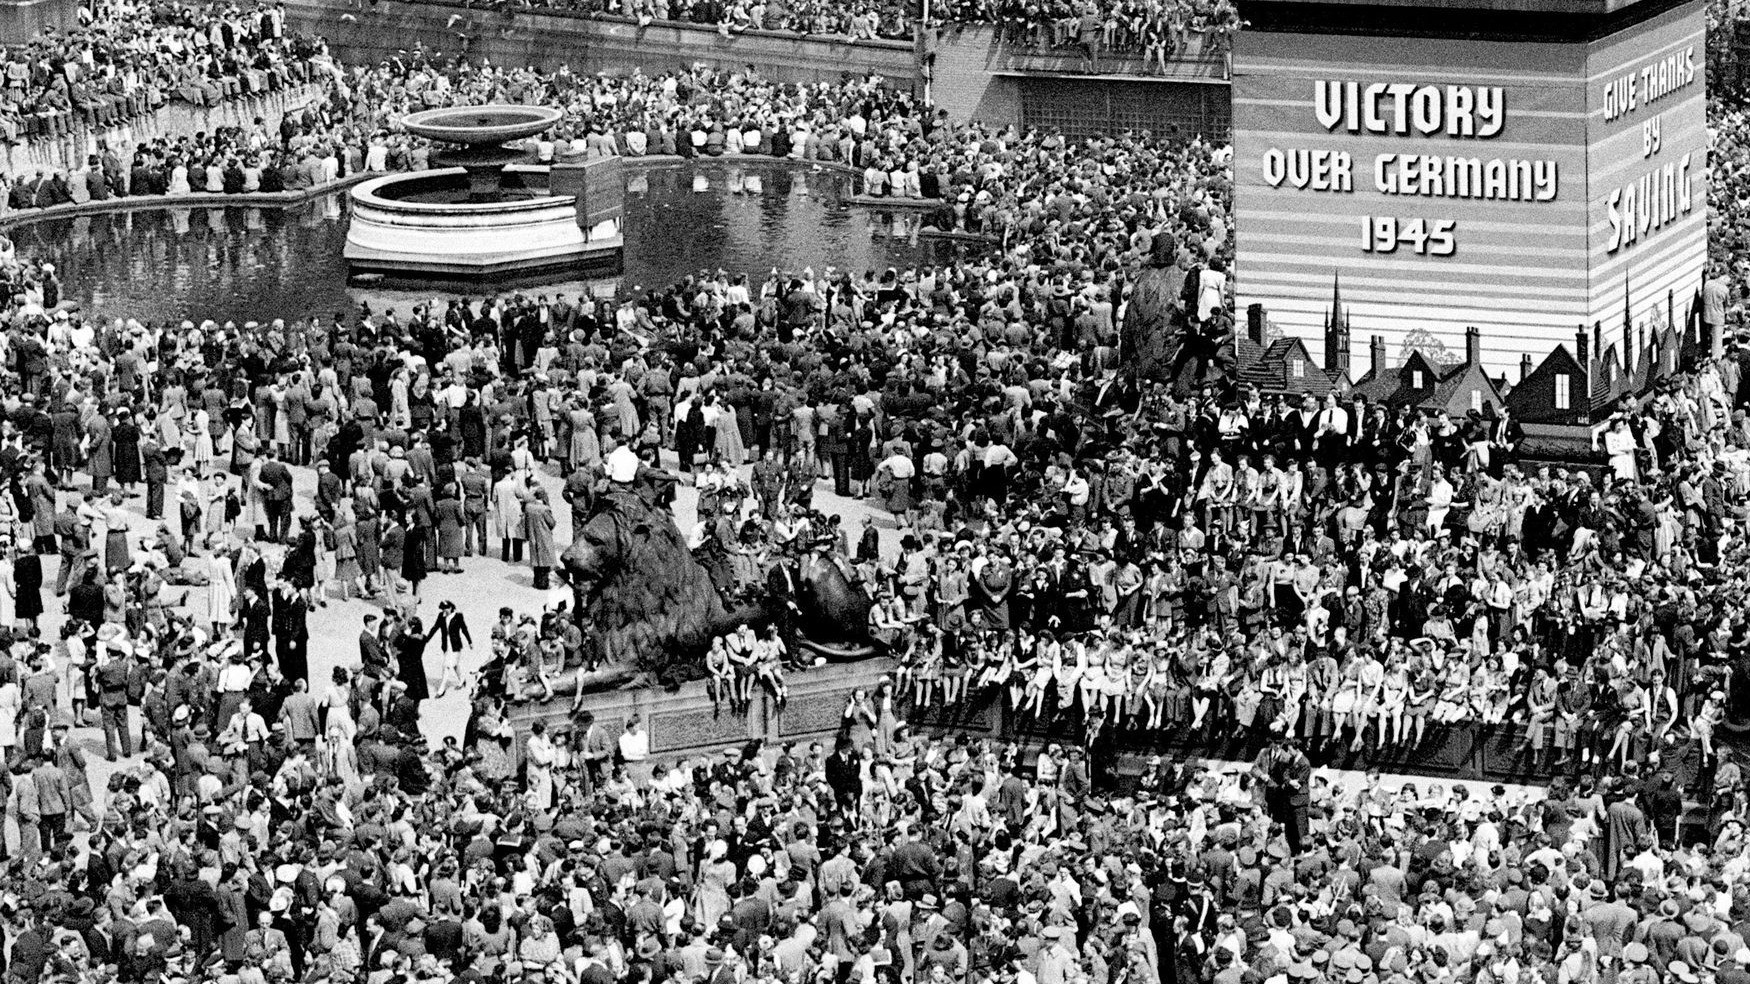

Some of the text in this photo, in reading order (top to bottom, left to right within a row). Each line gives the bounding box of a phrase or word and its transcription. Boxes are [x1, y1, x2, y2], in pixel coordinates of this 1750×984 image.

[1314, 79, 1506, 137] VICTORY
[1604, 46, 1693, 121] GIVE THANKS
[1644, 115, 1661, 158] BY
[1262, 147, 1558, 201] OVER GERMANY
[1608, 152, 1692, 254] SAVING
[1361, 215, 1457, 257] 1945
